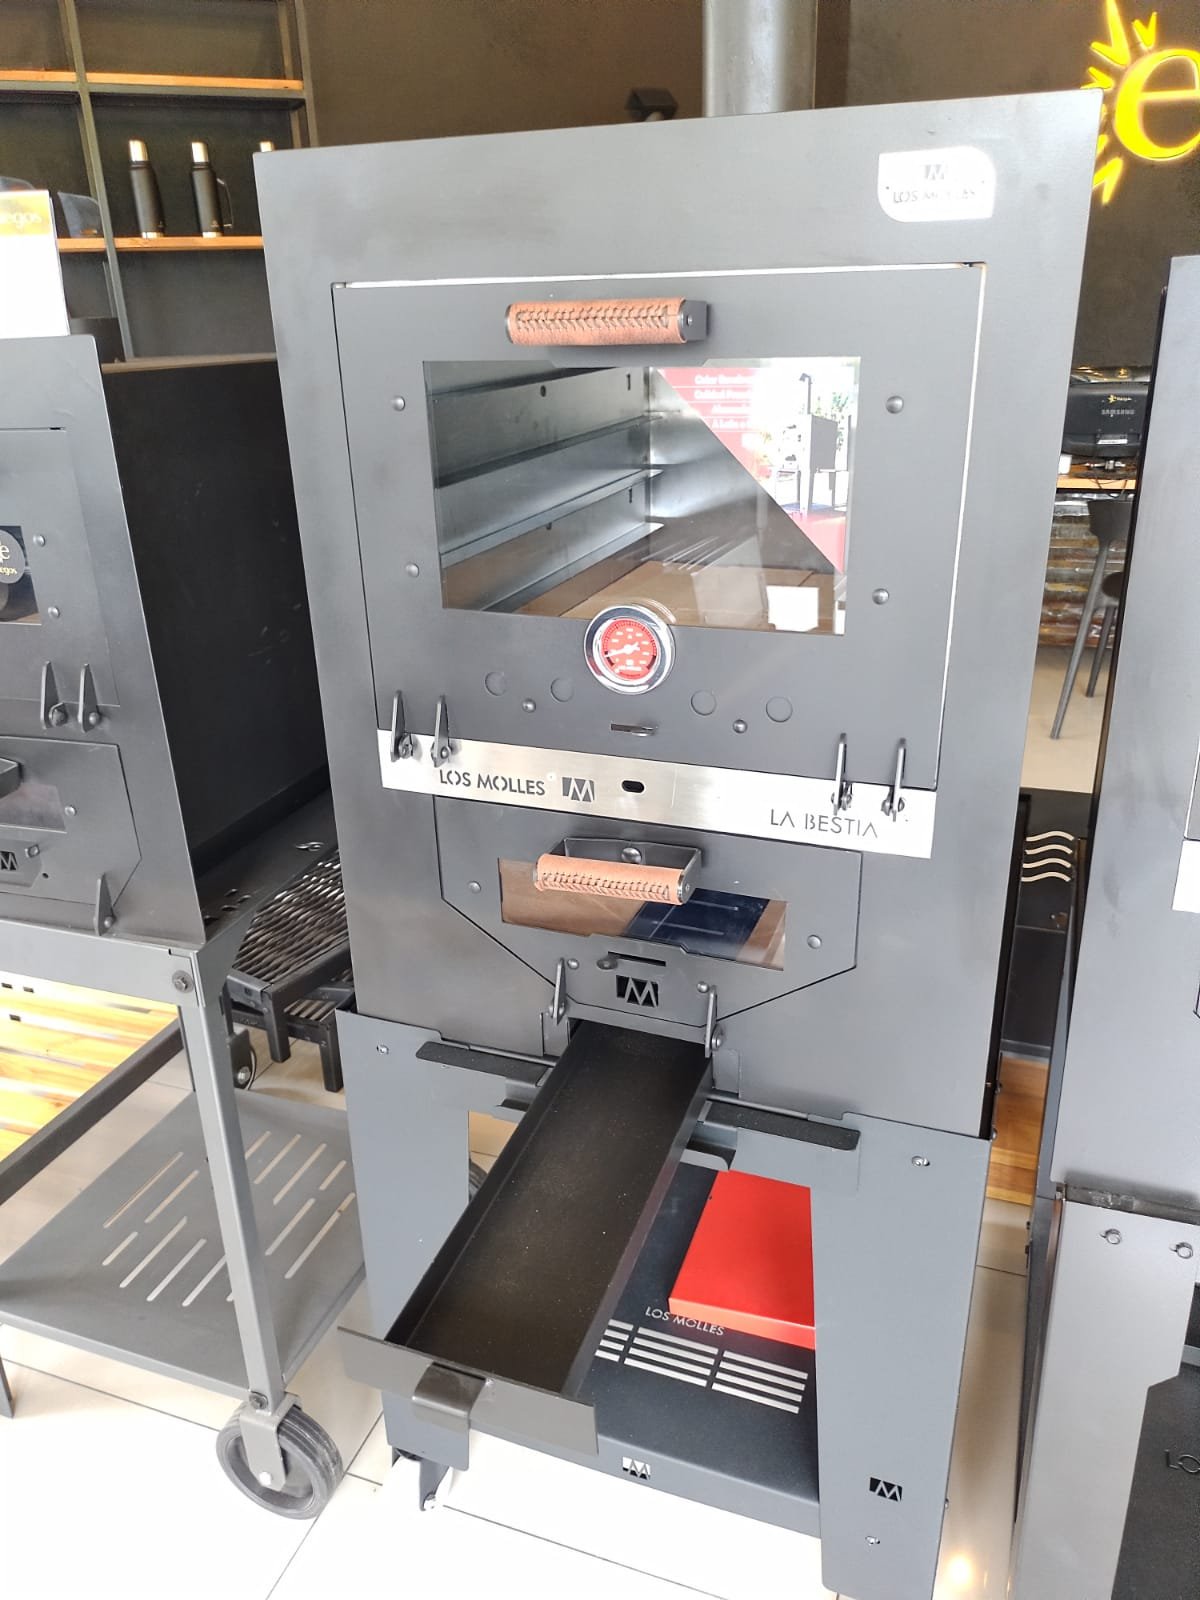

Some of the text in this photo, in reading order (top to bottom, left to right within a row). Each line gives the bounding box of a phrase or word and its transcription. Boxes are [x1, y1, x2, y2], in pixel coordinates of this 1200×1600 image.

[439, 769, 471, 787] LOS
[477, 774, 546, 796] MOLLES
[770, 808, 878, 839] LA BESTIA
[645, 1306, 725, 1336] LOS MOLLES
